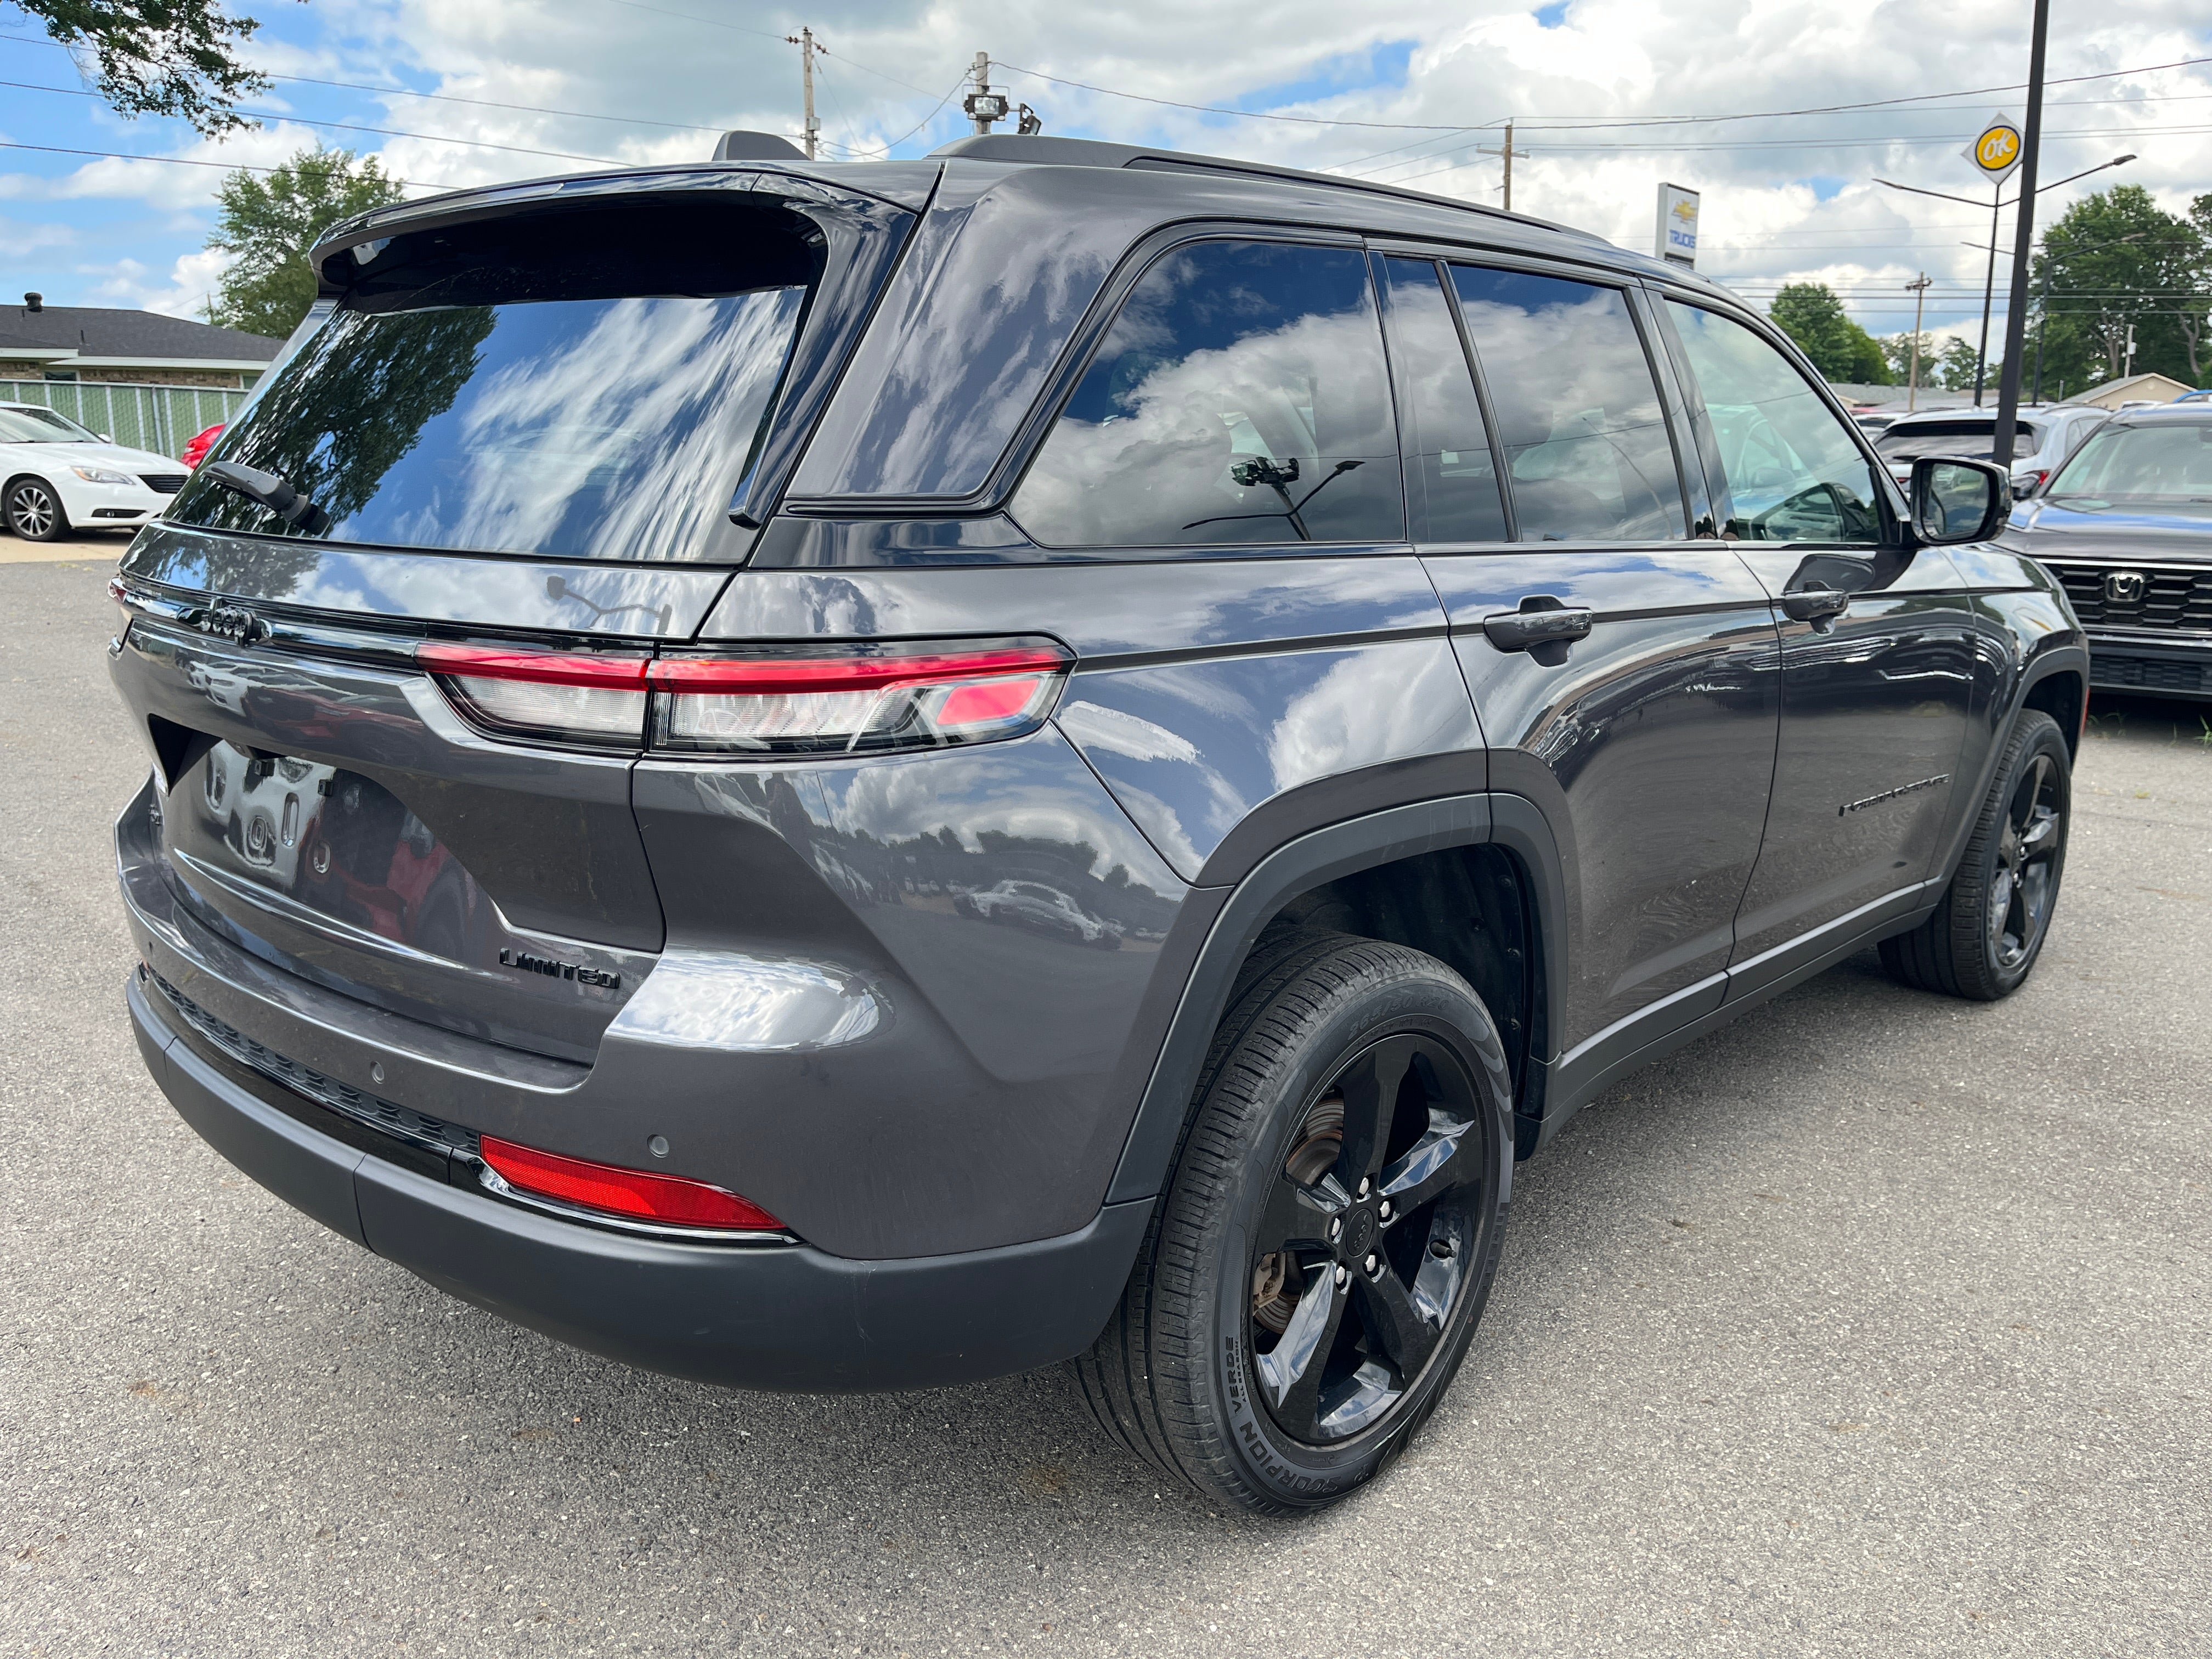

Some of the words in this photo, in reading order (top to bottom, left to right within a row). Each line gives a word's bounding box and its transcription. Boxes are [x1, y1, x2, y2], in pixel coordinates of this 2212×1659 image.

[1983, 132, 2014, 161] OK
[499, 947, 620, 989] LIMITED
[1226, 1336, 1242, 1414] VERDE
[1239, 1421, 1341, 1493] SCORPION
